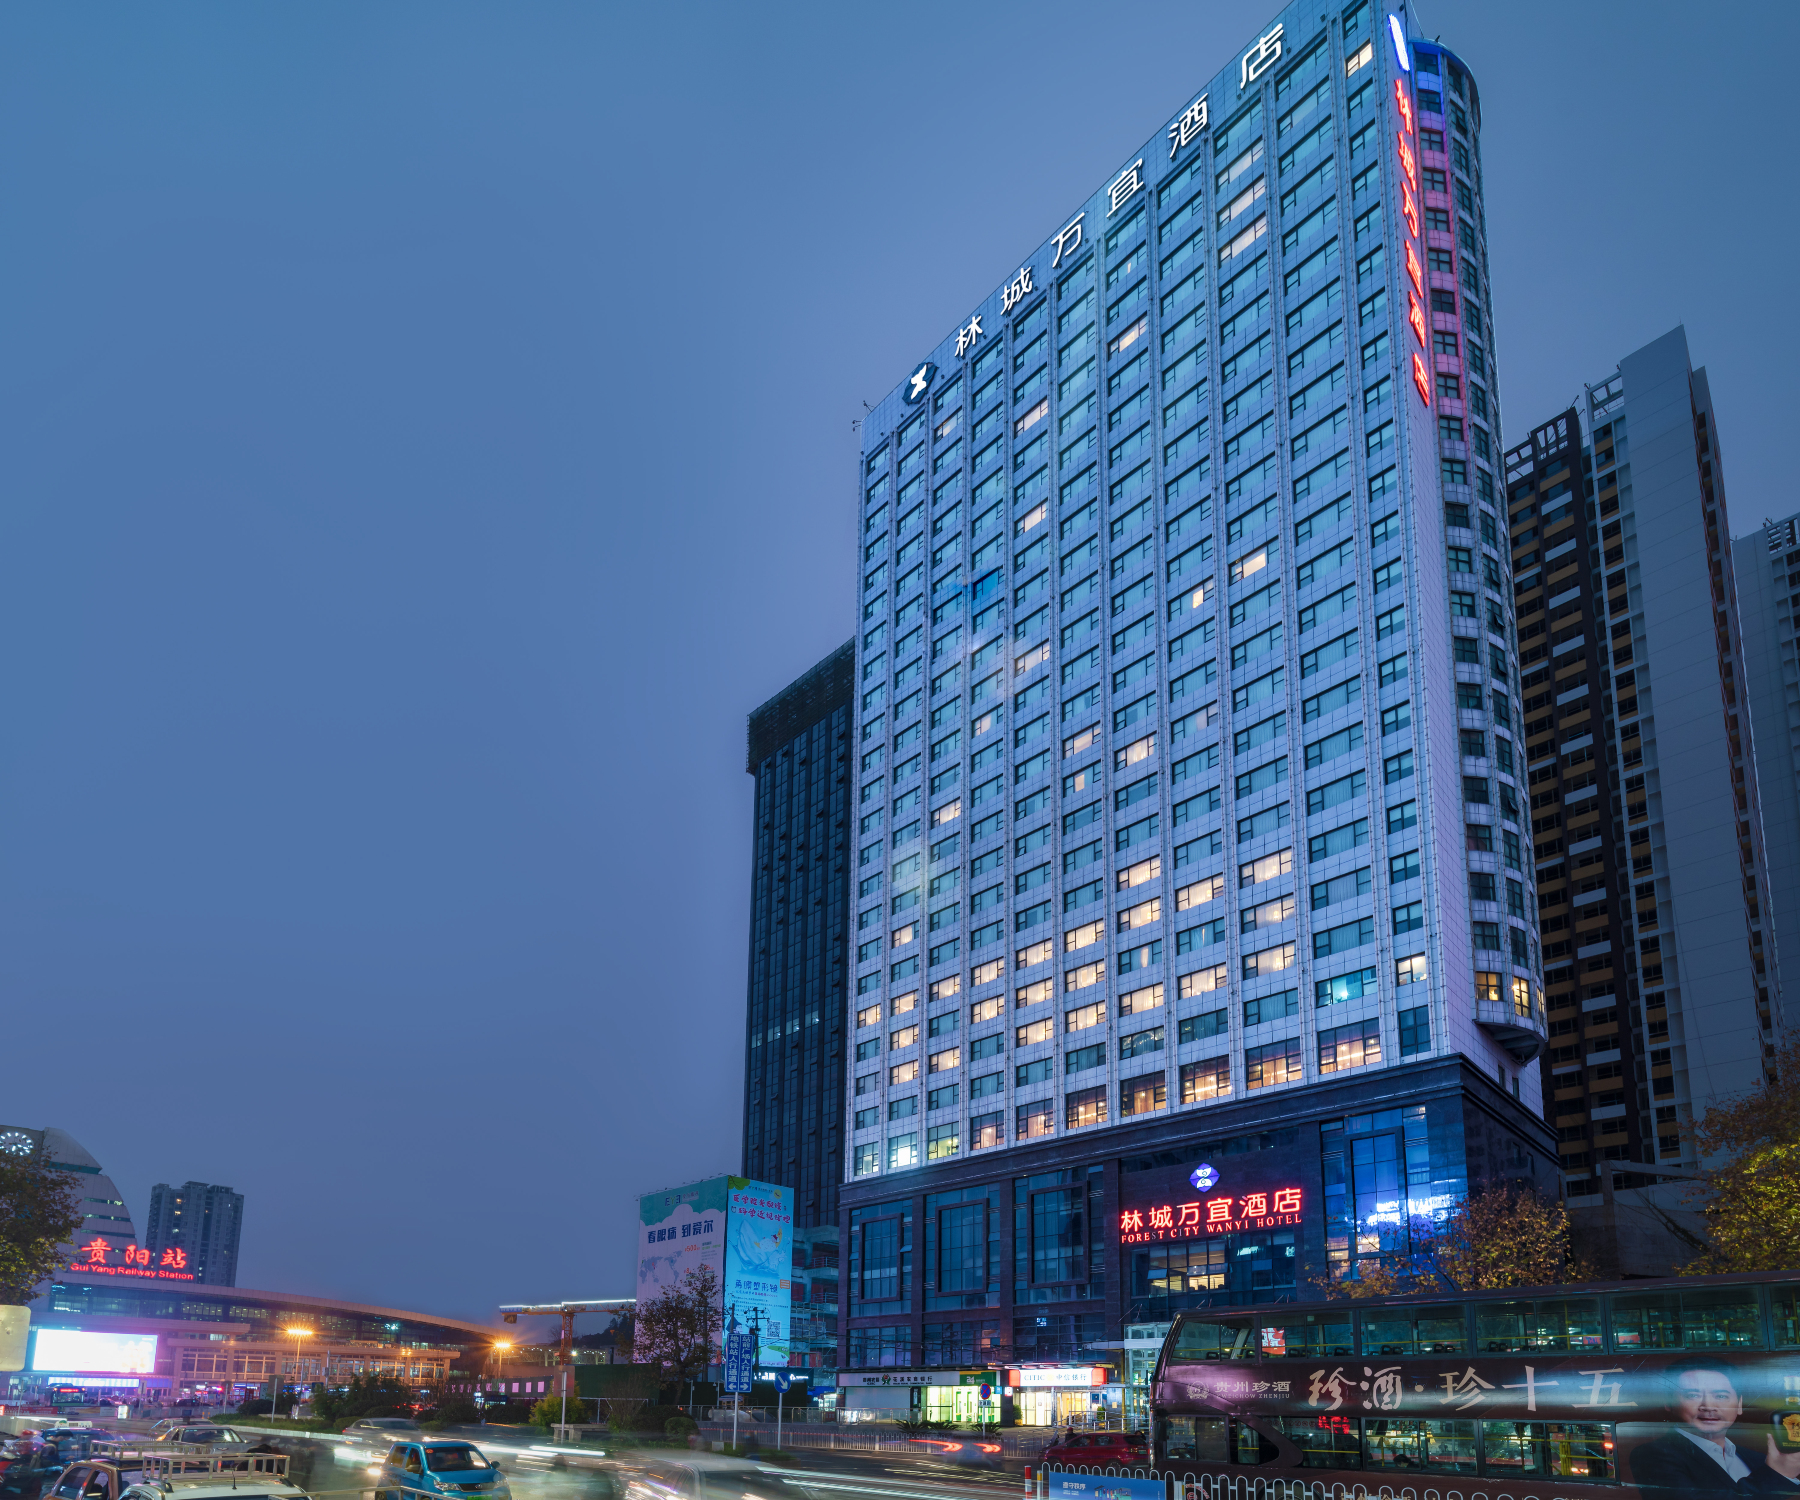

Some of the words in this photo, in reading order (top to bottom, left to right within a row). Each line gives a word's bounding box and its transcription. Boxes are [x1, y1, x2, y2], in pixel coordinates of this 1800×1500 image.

[954, 23, 1284, 357] 林城万宜酒店
[1120, 1187, 1302, 1233] 林城万宜酒店
[647, 1226, 677, 1244] 看眼病
[681, 1219, 714, 1238] 到爱尔
[1121, 1230, 1165, 1244] FOREST
[1170, 1225, 1200, 1238] CITY
[1206, 1220, 1249, 1233] WANYI
[1257, 1213, 1302, 1228] HOTEL
[81, 1237, 187, 1269] 贵阳站
[70, 1263, 89, 1272] Gui
[91, 1264, 116, 1275] Yang
[117, 1266, 156, 1278] Railway
[158, 1270, 194, 1280] Station
[728, 1335, 739, 1383] 地铁站人行通道
[741, 1336, 751, 1383] 站前广场人行通道
[1213, 1380, 1292, 1393] 贵州珍酒
